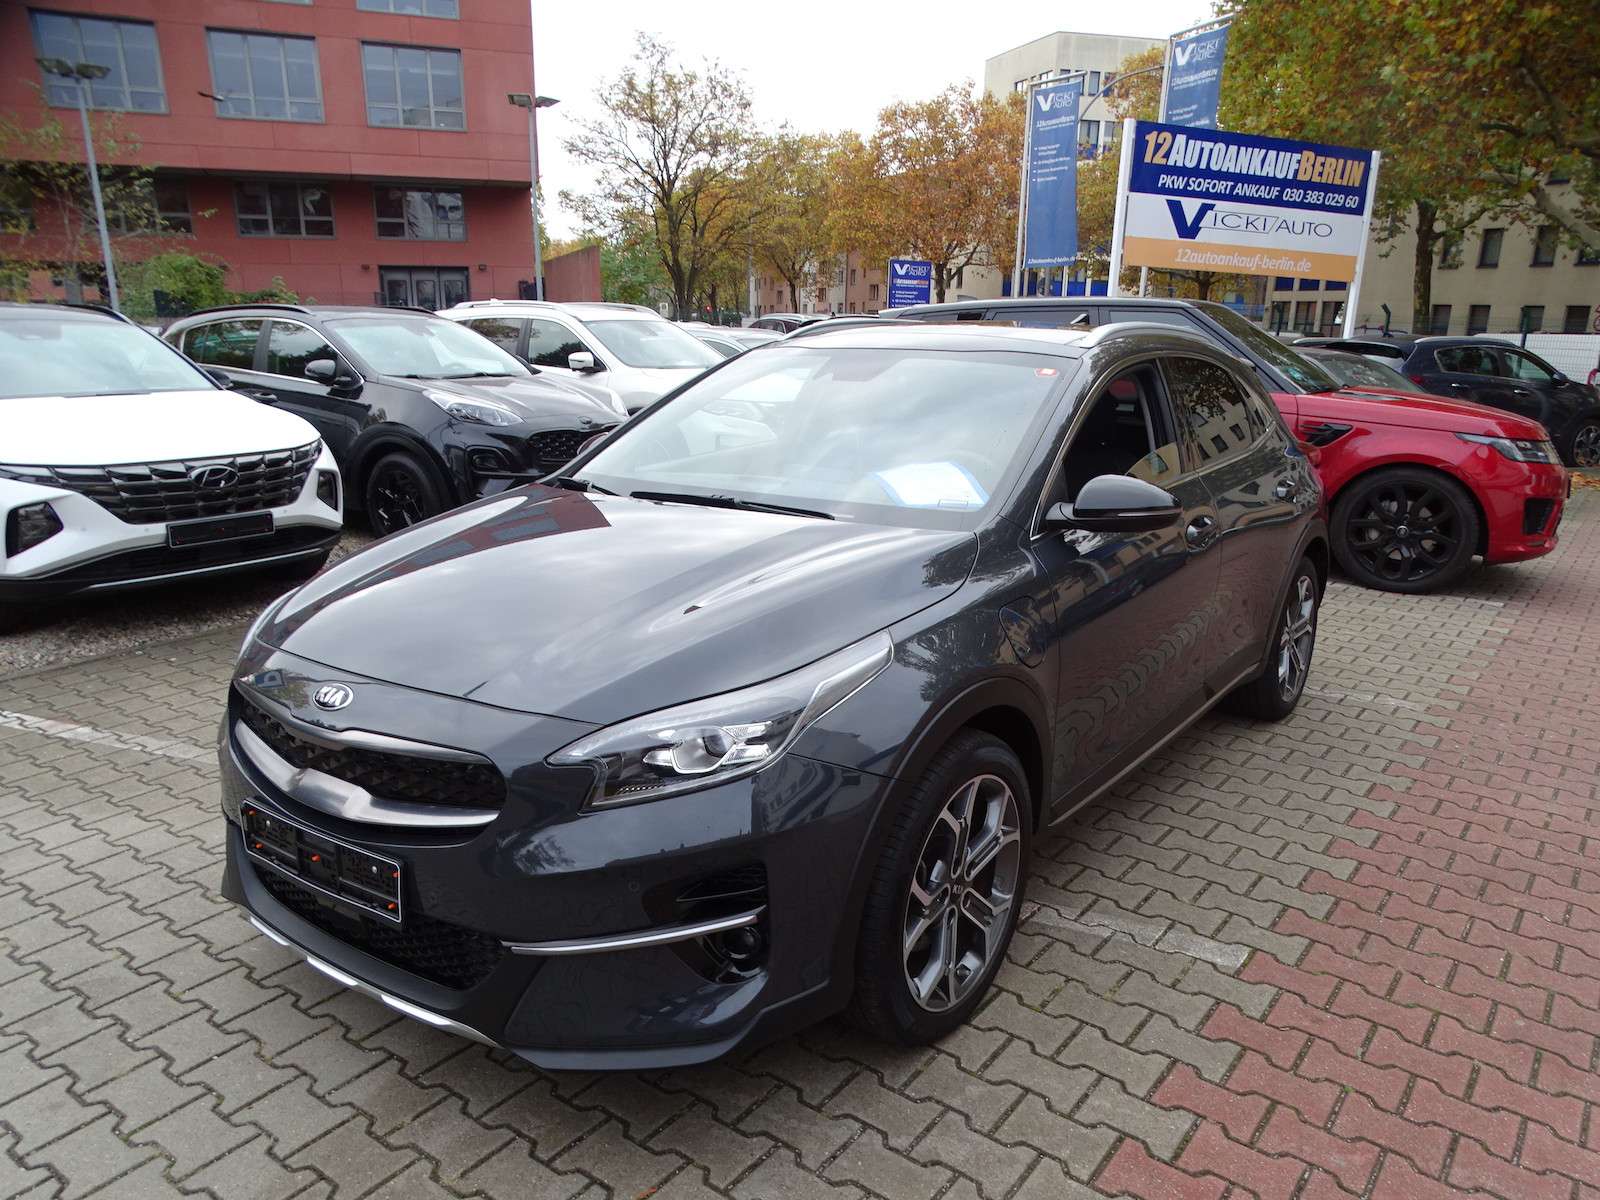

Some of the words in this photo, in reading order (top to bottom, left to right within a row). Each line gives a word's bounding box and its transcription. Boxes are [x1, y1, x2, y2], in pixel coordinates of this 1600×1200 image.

[1175, 39, 1220, 66] VICKI
[1036, 91, 1074, 112] VICKI
[1053, 101, 1072, 109] AUTO
[1144, 131, 1365, 187] 12AUTOANKAUFBERLIN
[1158, 174, 1188, 190] PKW
[1187, 177, 1234, 195] SOFORT
[1233, 182, 1281, 200] ANKAUF
[1283, 188, 1303, 201] 030
[1303, 191, 1324, 204] 383
[1325, 193, 1344, 207] 029
[1345, 196, 1359, 208] 60
[1275, 219, 1333, 238] AUTO
[1175, 247, 1312, 272] 12autoankauf-berlin.de
[315, 686, 346, 706] KIA
